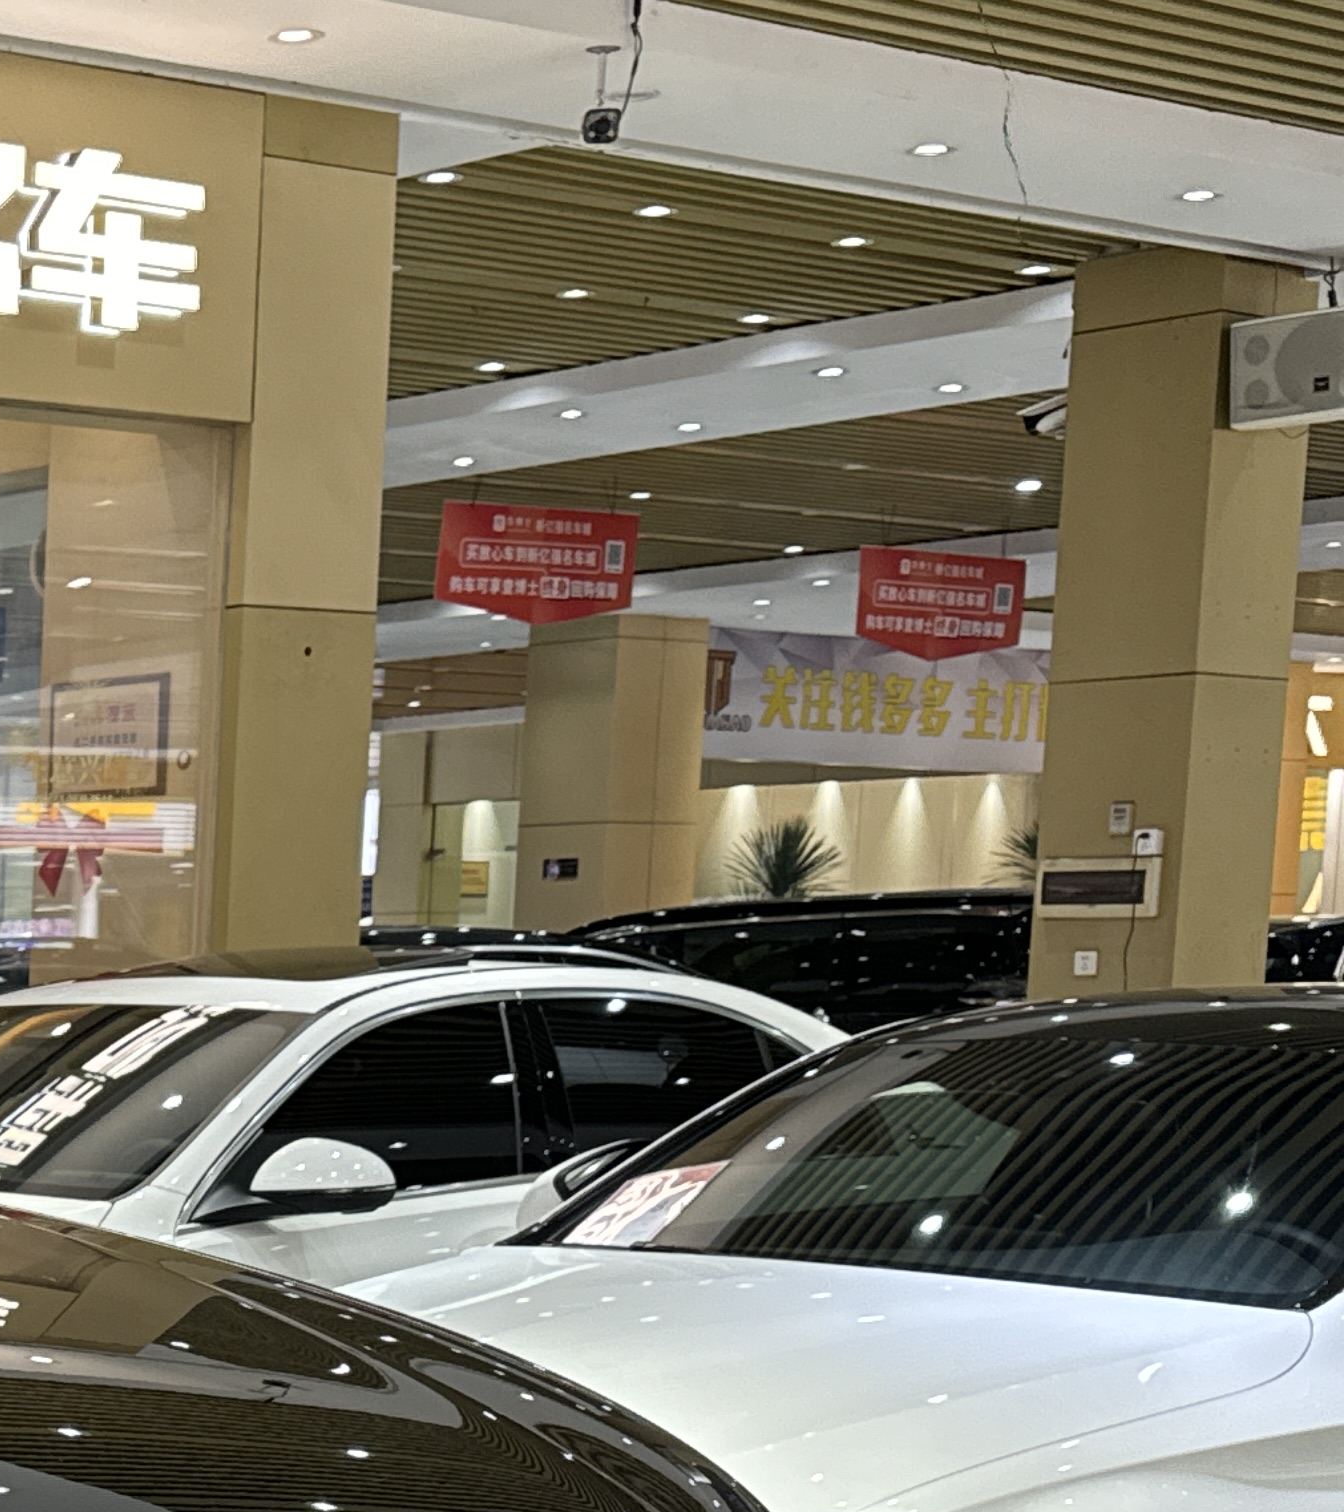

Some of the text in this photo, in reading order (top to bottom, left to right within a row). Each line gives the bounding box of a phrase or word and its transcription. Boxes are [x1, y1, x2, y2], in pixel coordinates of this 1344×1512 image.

[759, 664, 1049, 742] 关注钱多多 主打
